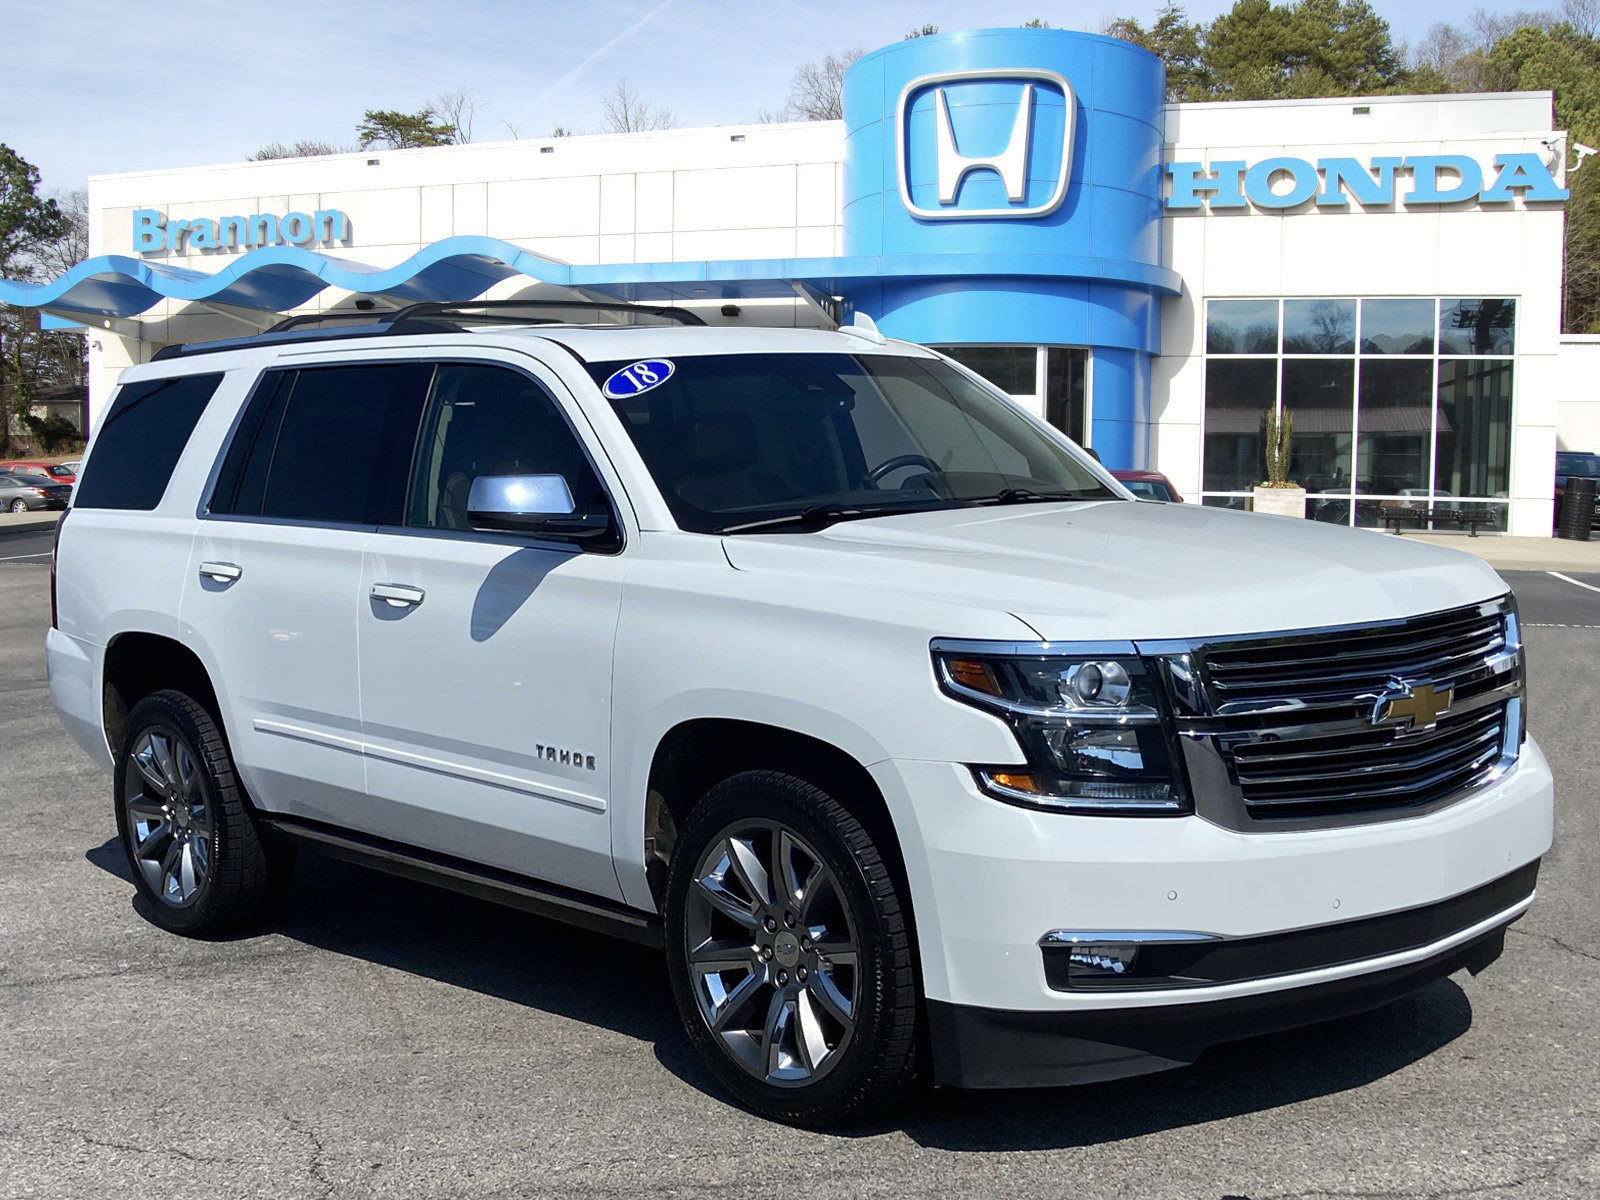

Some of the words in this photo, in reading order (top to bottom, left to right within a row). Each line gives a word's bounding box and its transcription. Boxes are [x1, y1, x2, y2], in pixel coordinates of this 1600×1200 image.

[1165, 153, 1569, 209] HONDA
[133, 208, 346, 253] Brannon
[615, 363, 659, 392] 18
[535, 743, 596, 771] TAHOE
